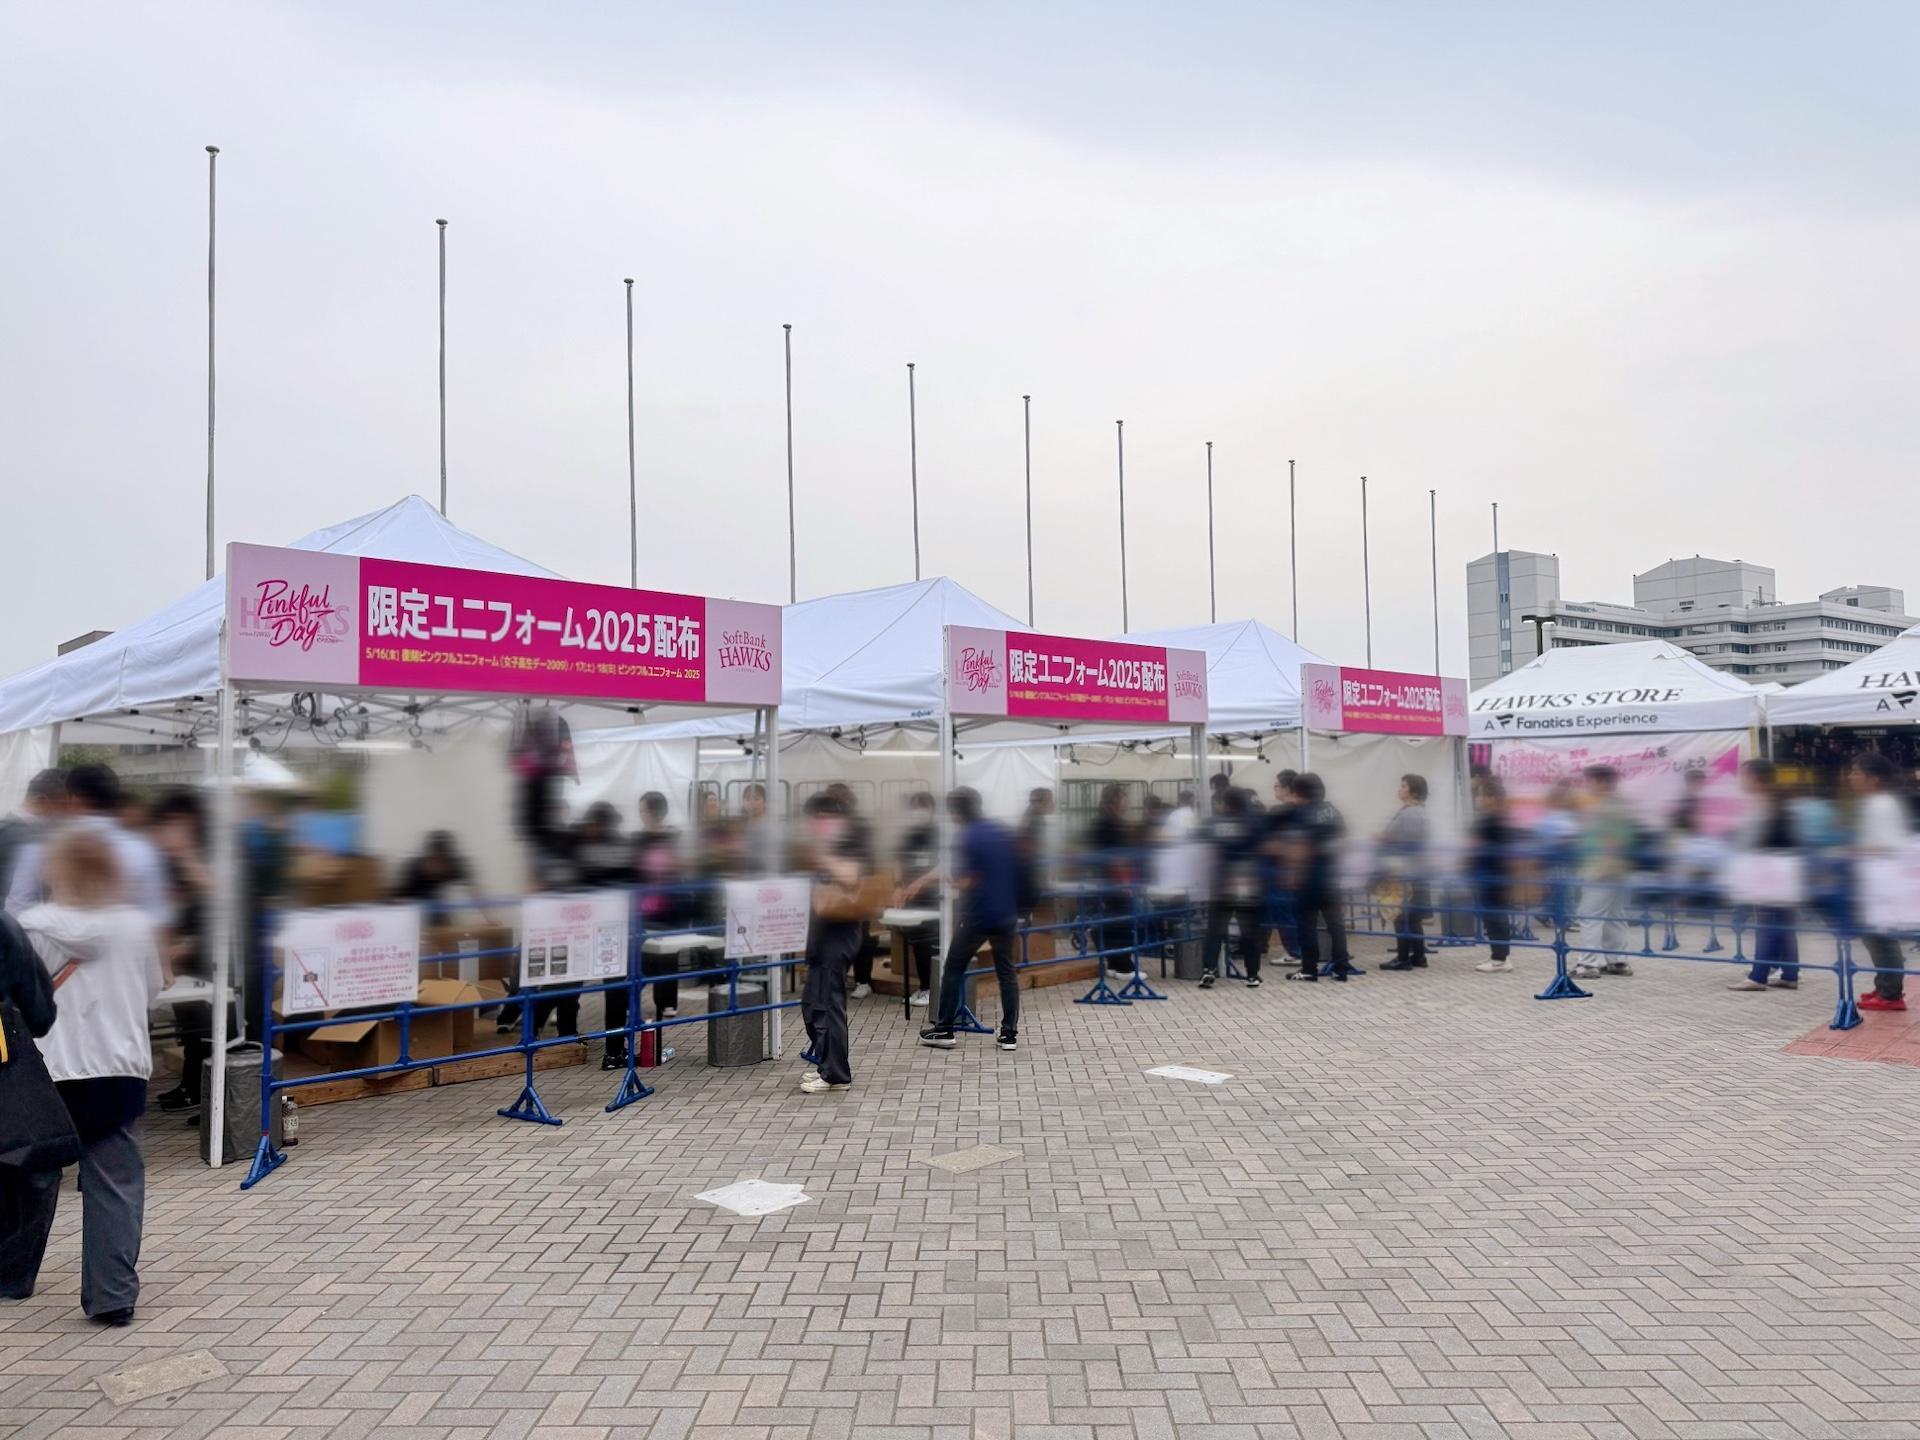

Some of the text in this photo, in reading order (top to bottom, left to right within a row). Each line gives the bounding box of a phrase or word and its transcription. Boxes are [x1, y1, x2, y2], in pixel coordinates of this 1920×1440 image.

[257, 578, 333, 625] Pinkful
[269, 617, 321, 652] Day
[367, 585, 701, 661] 限定ユニフォーム2025配布
[722, 630, 767, 649] SoftBank
[718, 645, 773, 672] HAWKS
[1009, 649, 1166, 693] 限定ユニフォーム2025配布
[684, 668, 701, 680] 2025
[1475, 692, 1577, 712] HAWKS
[1580, 687, 1684, 707] STORE
[1876, 698, 1891, 712] A
[1484, 713, 1659, 732] A Fanatics Experience
